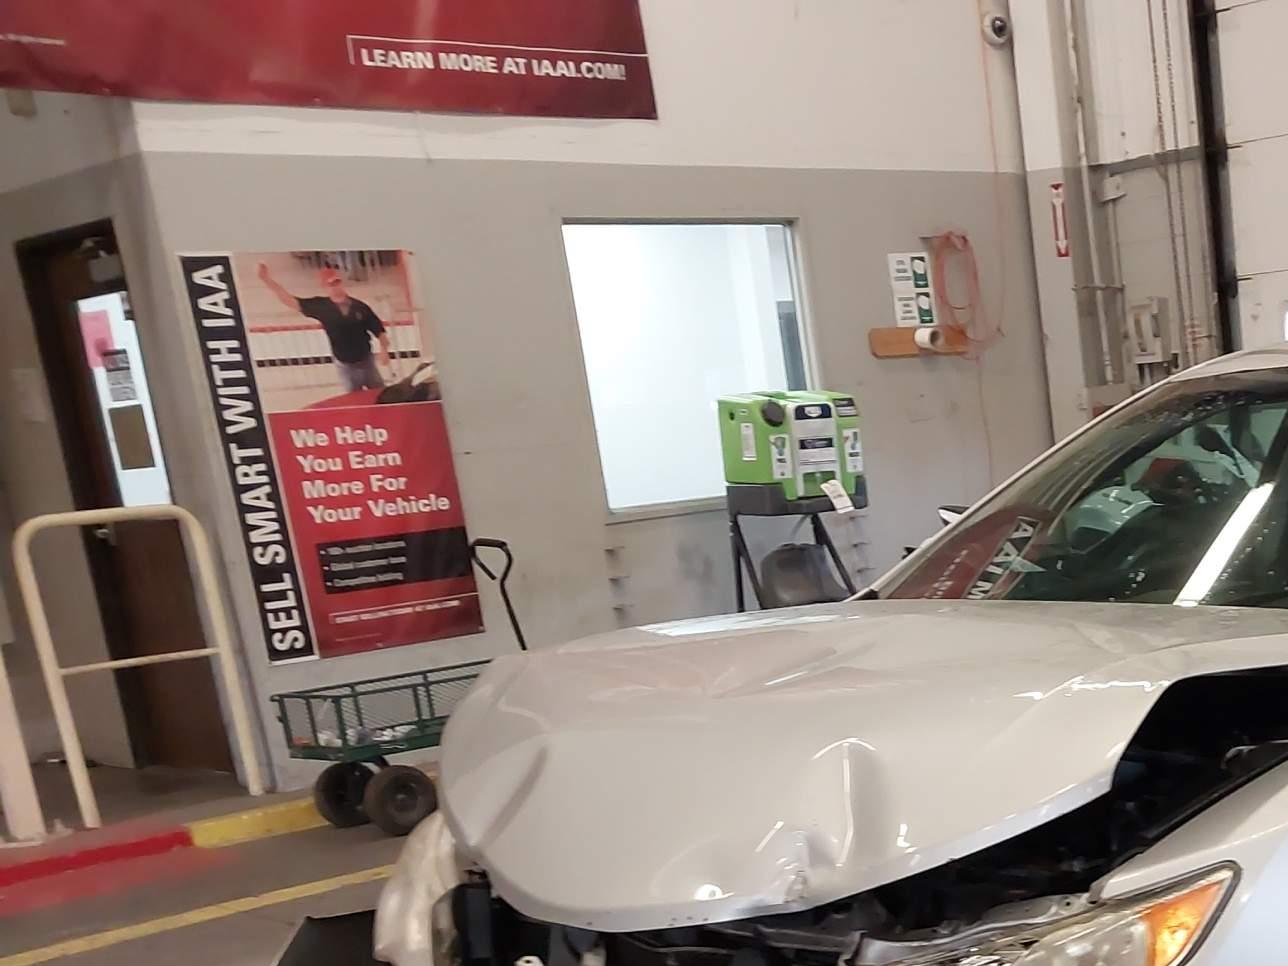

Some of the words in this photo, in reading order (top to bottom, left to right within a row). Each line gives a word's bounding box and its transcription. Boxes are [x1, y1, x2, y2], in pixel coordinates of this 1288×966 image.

[361, 48, 435, 70] LEARN
[438, 52, 498, 74] MORE
[502, 57, 528, 76] AT
[532, 59, 627, 81] IAAI.COM!
[191, 264, 236, 328] IAA
[206, 339, 258, 434] WITH
[290, 428, 329, 448] We
[334, 424, 388, 446] Help
[296, 455, 343, 473] You
[348, 450, 402, 469] Earn
[302, 479, 365, 499] More
[369, 474, 408, 492] For
[229, 443, 287, 566] SMART
[306, 505, 363, 524] Your
[367, 494, 450, 517] Vehicle
[258, 572, 306, 651] SELL
